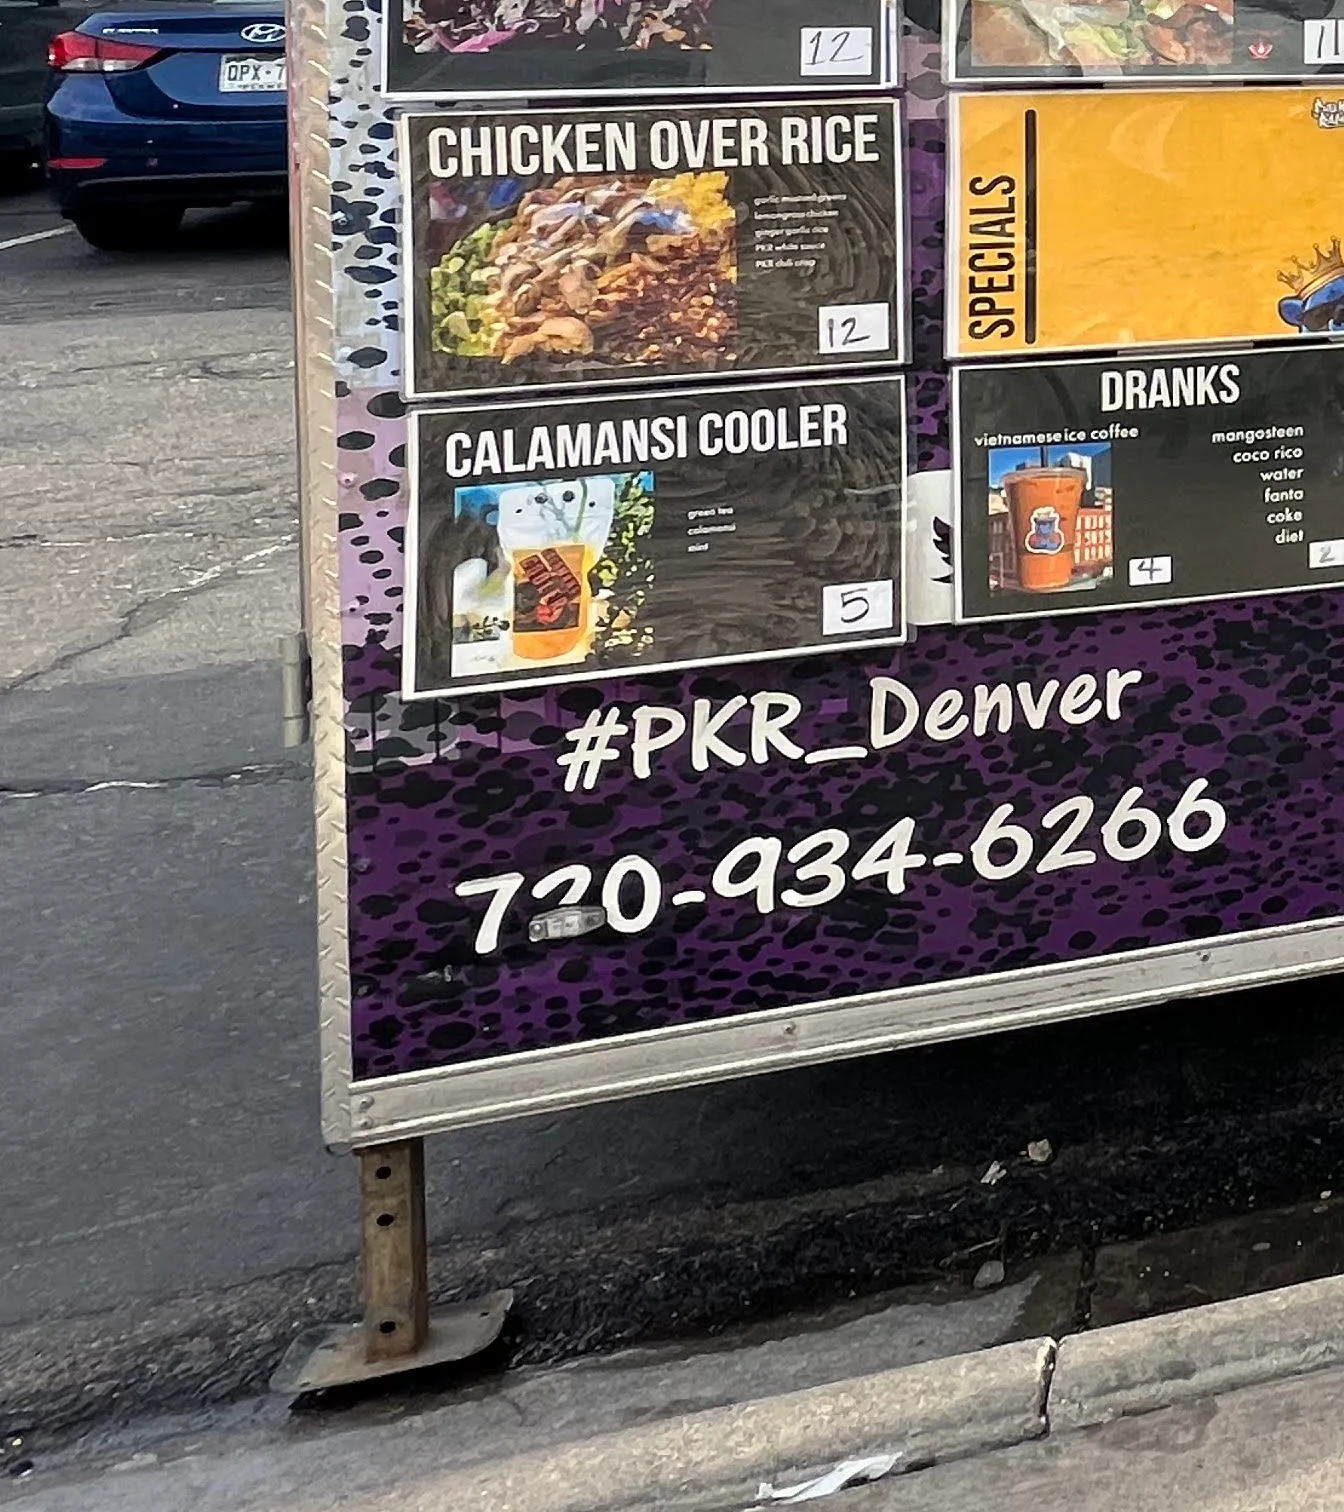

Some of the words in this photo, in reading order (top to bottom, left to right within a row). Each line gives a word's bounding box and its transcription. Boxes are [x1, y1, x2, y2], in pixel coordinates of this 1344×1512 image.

[808, 31, 863, 67] 12
[428, 122, 637, 178] CHICKEN
[650, 118, 769, 170] OVER
[780, 114, 880, 165] RICE
[968, 174, 1016, 340] SPECIALS
[826, 317, 871, 348] 12
[1101, 364, 1241, 412] DRANKS
[446, 415, 687, 478] CALAMANSI
[699, 403, 848, 457] COOLER
[974, 430, 1062, 448] vietnamese
[1063, 429, 1087, 442] ice
[1090, 424, 1139, 441] coffee
[1212, 424, 1304, 445] mangosteen
[1233, 449, 1271, 464] coco
[1274, 445, 1304, 461] rico
[1260, 466, 1304, 482] water
[1263, 486, 1304, 504] fanta
[1267, 507, 1303, 524] coke
[1275, 528, 1304, 545] diet
[1319, 546, 1337, 564] 2
[1137, 558, 1163, 581] 4
[840, 589, 870, 624] 5
[556, 668, 1142, 793] #PKR_Denver
[455, 778, 1227, 954] 720-934-6266
